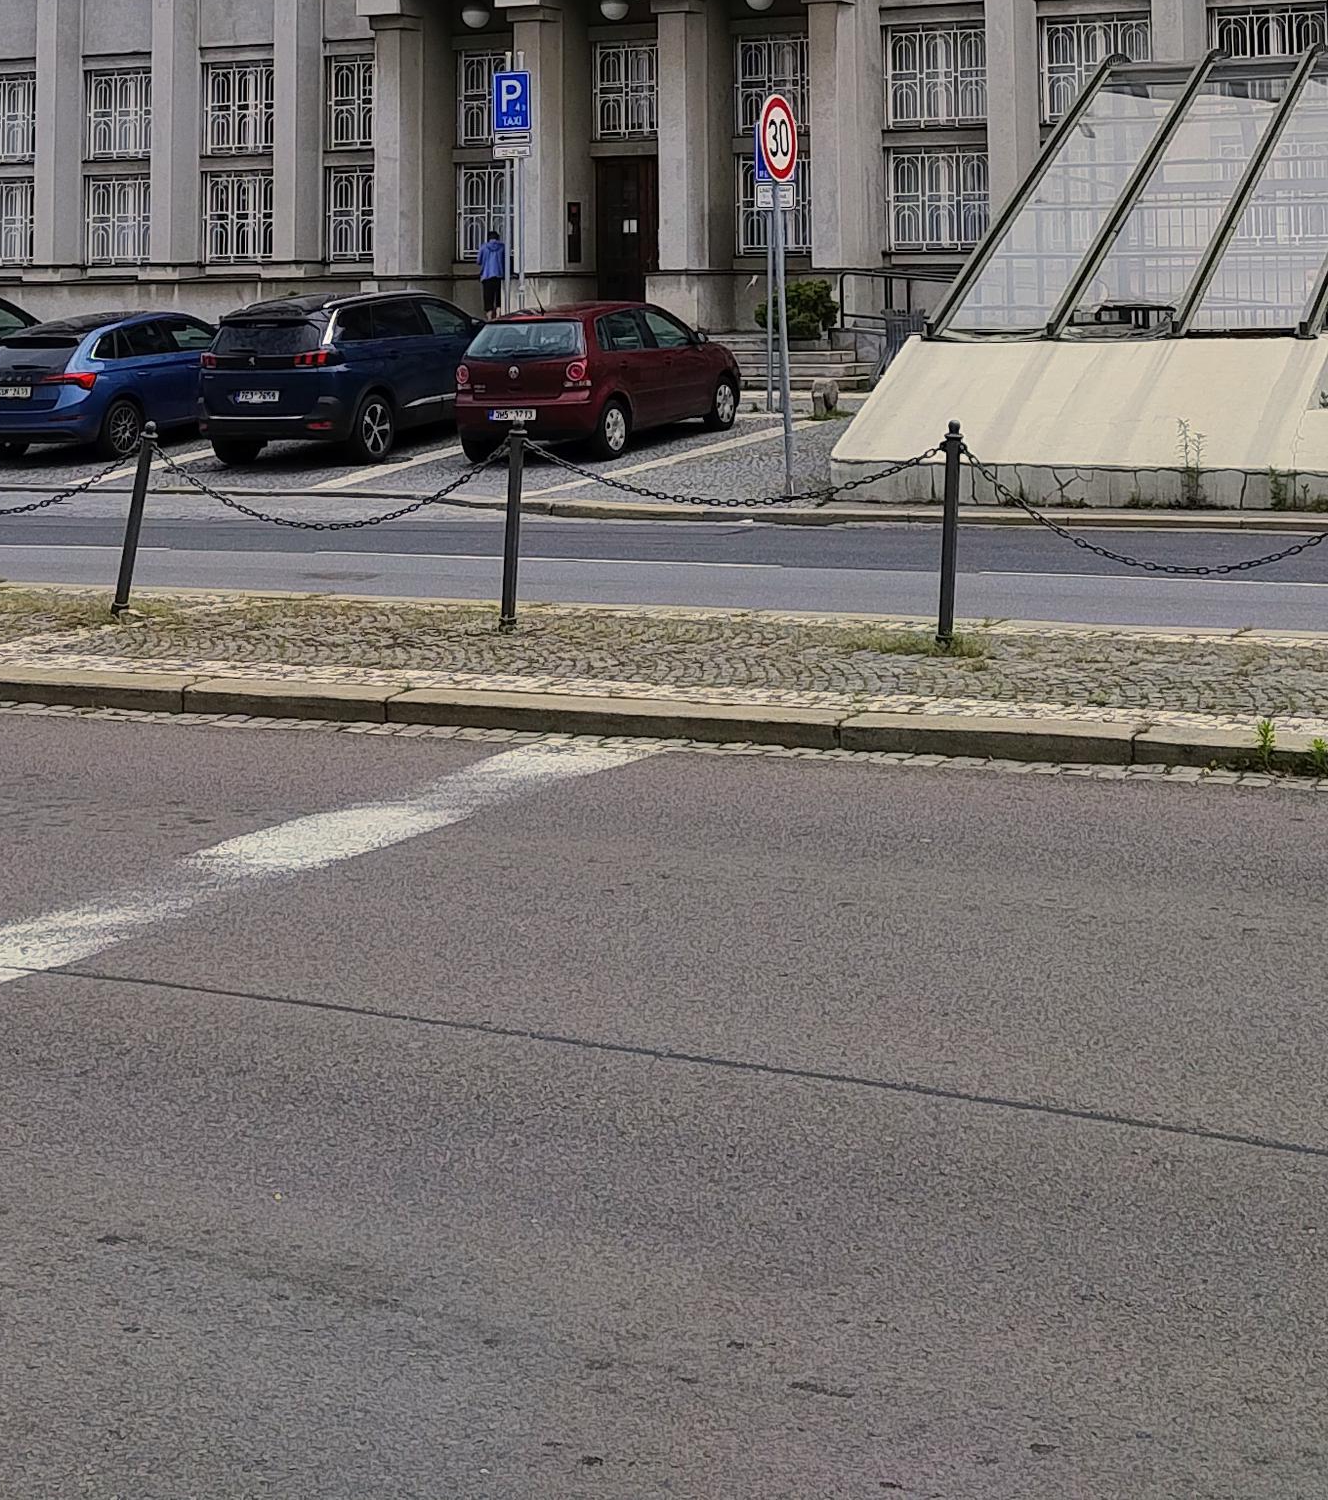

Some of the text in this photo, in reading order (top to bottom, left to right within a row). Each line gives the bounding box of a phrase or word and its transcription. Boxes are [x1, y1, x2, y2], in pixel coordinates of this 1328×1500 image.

[501, 80, 522, 113] P
[502, 115, 522, 126] TAXI
[768, 119, 789, 158] 30
